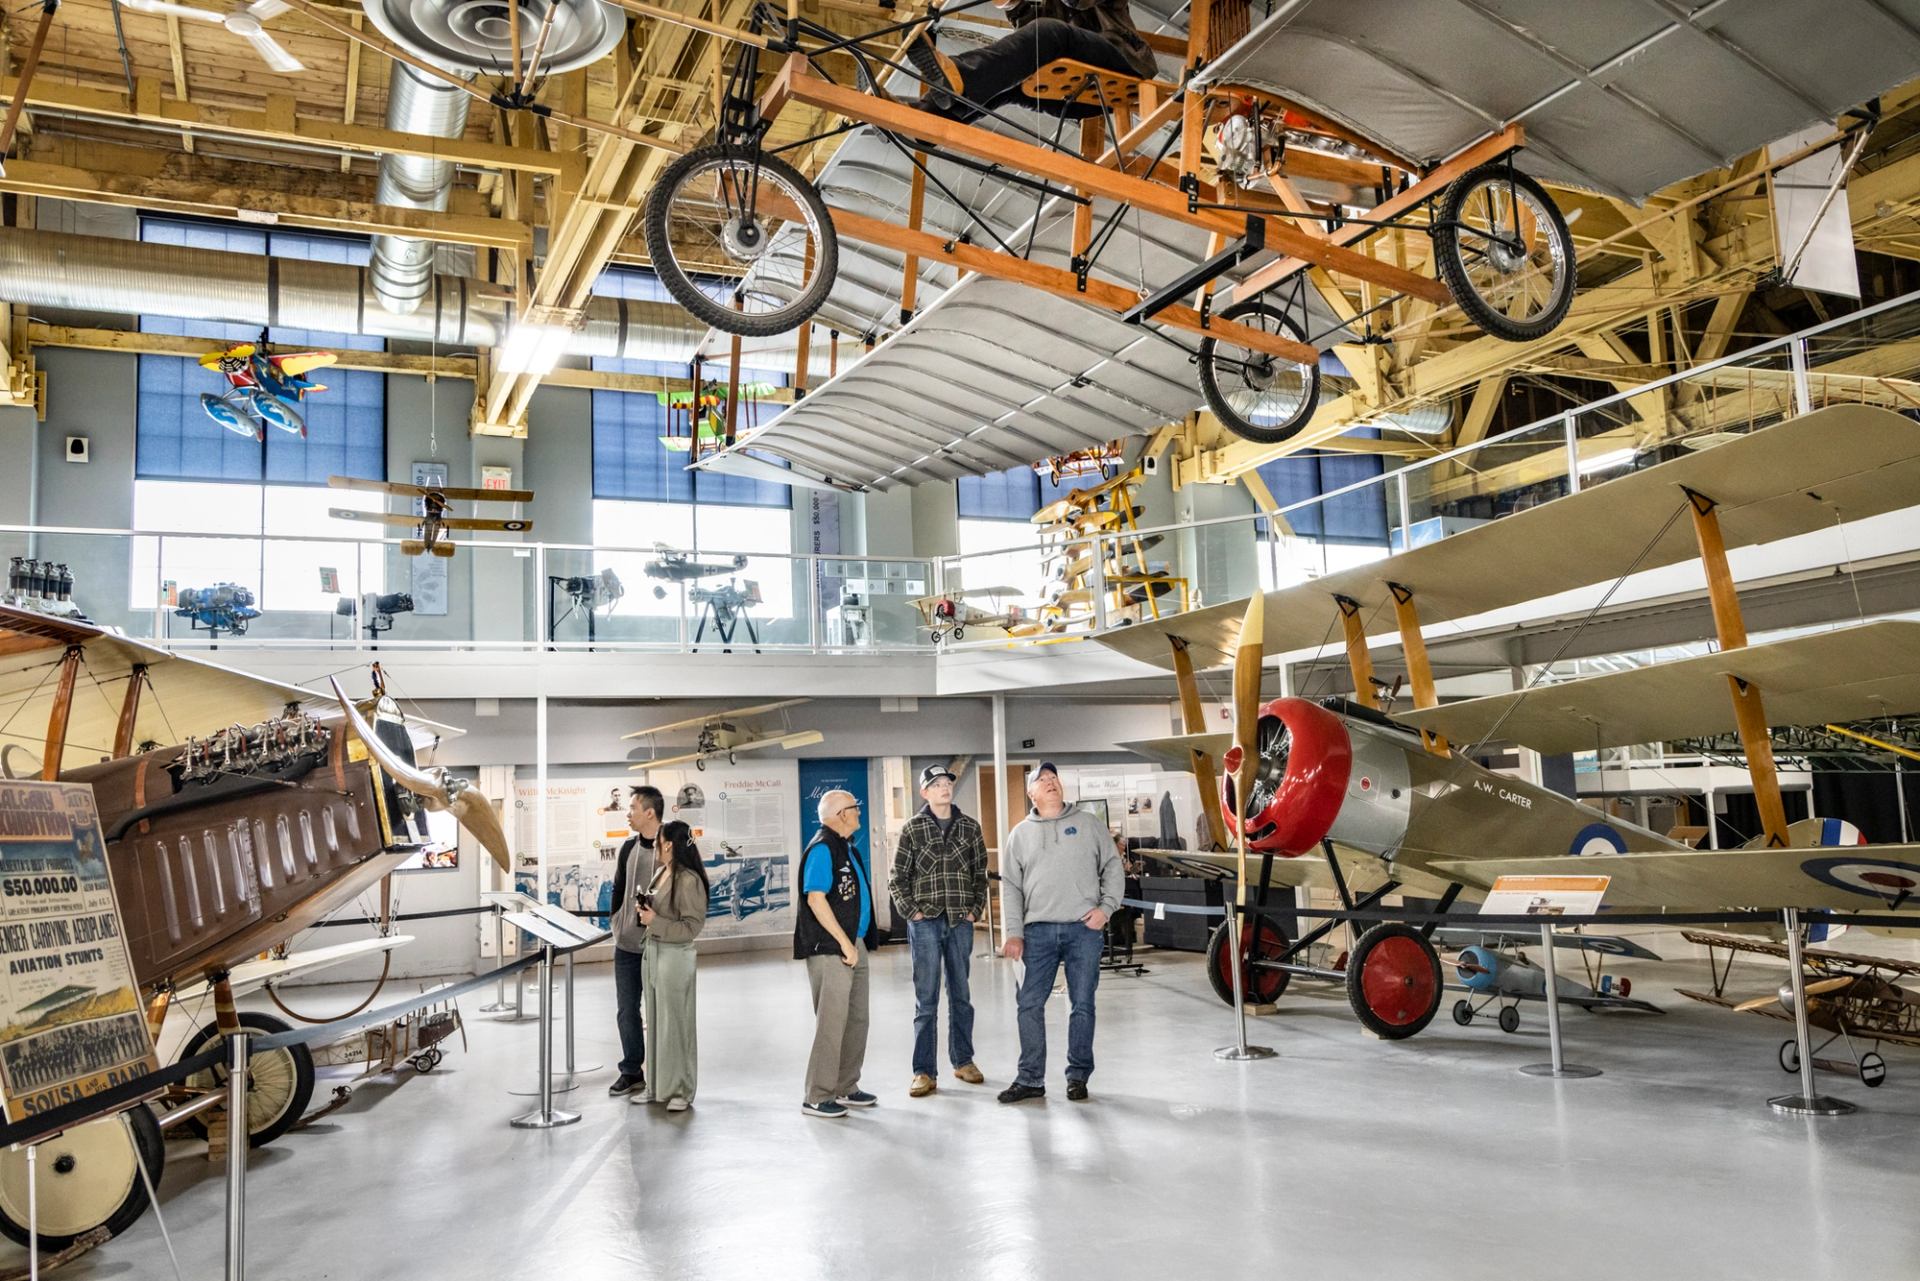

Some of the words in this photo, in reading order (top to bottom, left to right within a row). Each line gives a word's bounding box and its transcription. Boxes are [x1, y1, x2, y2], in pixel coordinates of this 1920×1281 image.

[485, 478, 506, 490] EXIT
[0, 789, 54, 811] ALGARY
[1473, 780, 1495, 795] A.W.
[1499, 788, 1531, 809] CARTER
[3, 876, 78, 897] $50,000.00
[0, 925, 29, 954] ENGER
[29, 920, 71, 949] CARRYING
[72, 913, 118, 944] AEROPLANES
[10, 954, 62, 975] AVIATION
[65, 948, 103, 966] STUNTS
[23, 1083, 84, 1115] SOUSA
